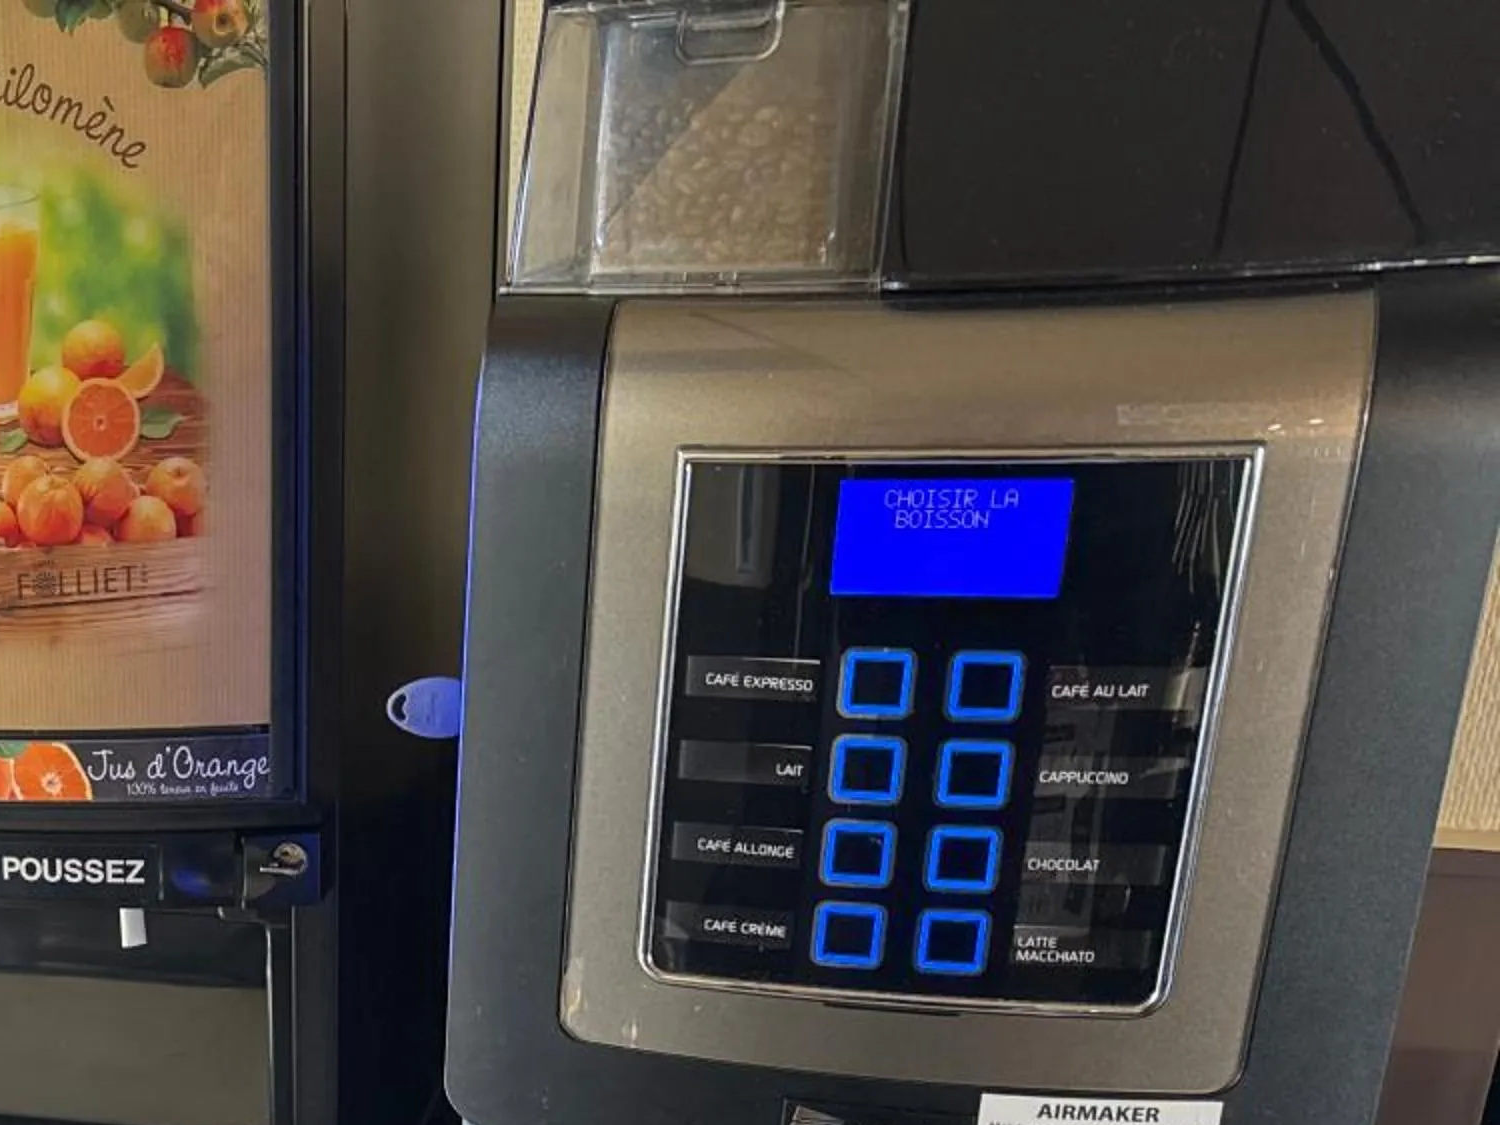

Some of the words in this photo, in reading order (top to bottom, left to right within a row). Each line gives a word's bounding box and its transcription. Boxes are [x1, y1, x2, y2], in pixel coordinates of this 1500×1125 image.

[884, 488, 979, 509] CHOISIR
[990, 488, 1019, 509] LA
[894, 509, 990, 529] BOISSON
[743, 675, 813, 693] EXPRESSO
[1093, 684, 1115, 697] AU
[1118, 684, 1150, 697] LAIT
[87, 749, 136, 781] Jus
[147, 745, 271, 789] d'Orange
[776, 763, 804, 777] LAIT
[1039, 770, 1129, 785] CAPPUCCINO
[2, 855, 146, 884] POUSSEZ
[1027, 858, 1101, 872] CHOCOLAT
[1017, 936, 1058, 949] LATTE
[1015, 949, 1096, 963] MACCHIATO
[1037, 1103, 1160, 1123] AIRMAKER
